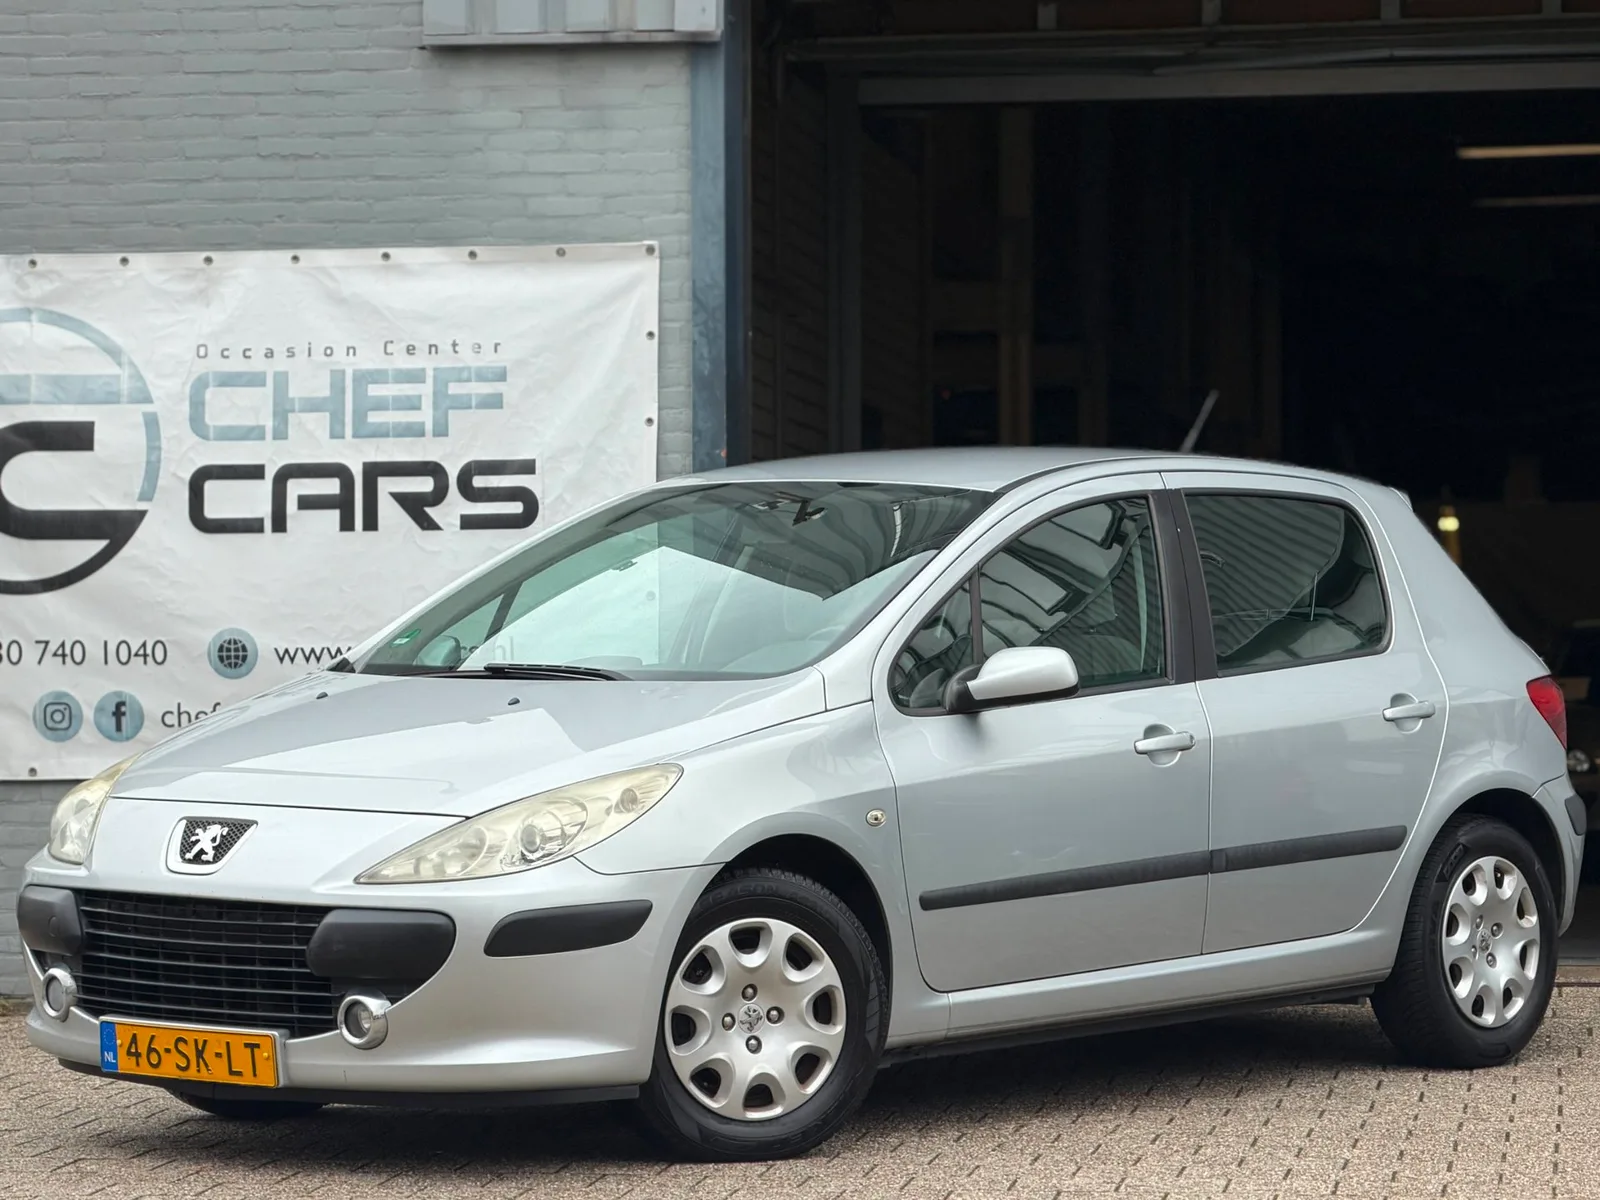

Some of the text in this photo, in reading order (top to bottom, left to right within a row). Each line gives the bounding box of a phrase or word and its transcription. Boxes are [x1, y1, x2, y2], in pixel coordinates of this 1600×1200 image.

[196, 339, 502, 360] Occasion Center
[189, 365, 508, 442] CHEF
[188, 458, 540, 534] CARS
[0, 639, 168, 666] 0 740 1040
[104, 1051, 117, 1063] NL
[125, 1032, 261, 1078] 46-SK-LT
